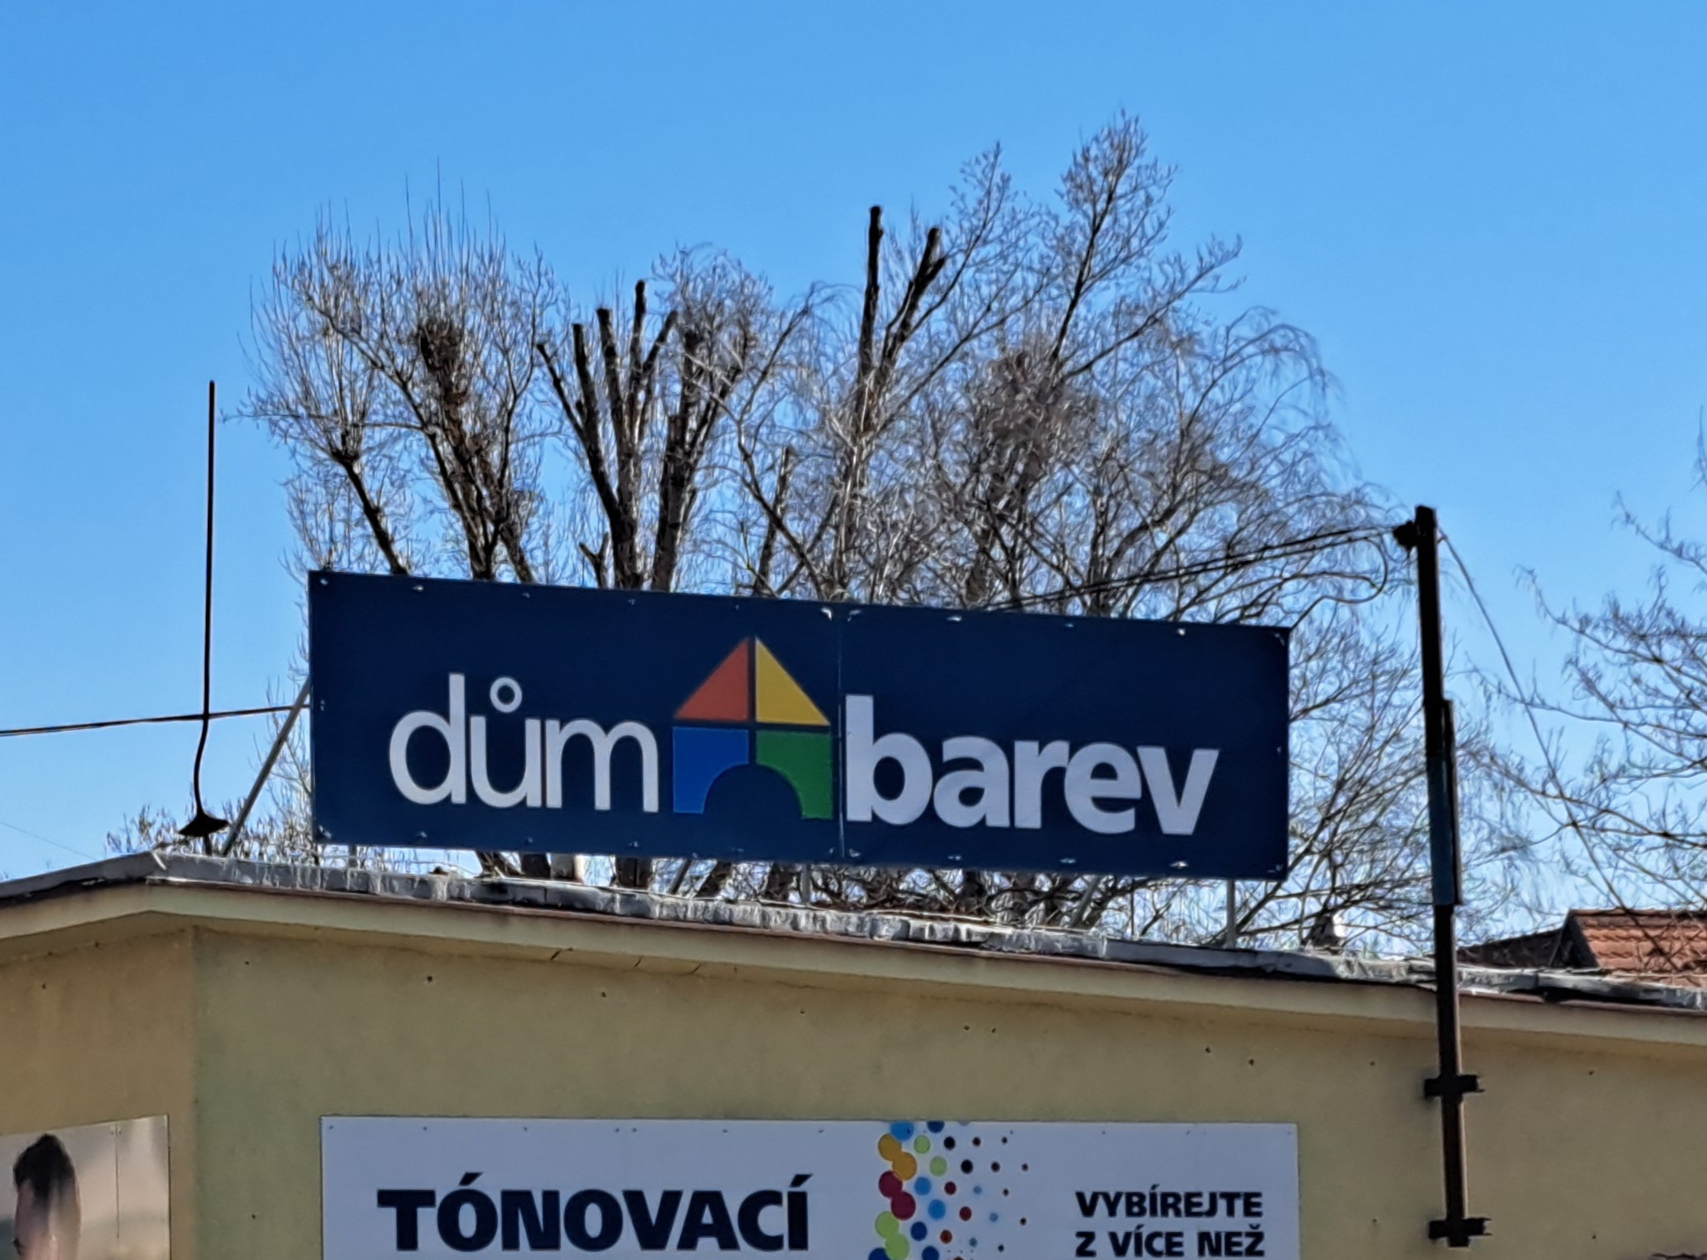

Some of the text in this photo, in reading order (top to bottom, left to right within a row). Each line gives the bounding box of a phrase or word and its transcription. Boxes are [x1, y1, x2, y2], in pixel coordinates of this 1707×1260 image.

[388, 672, 1220, 836] dům barev
[377, 1172, 813, 1252] TÓNOVACÍ
[1075, 1183, 1263, 1218] VYBÍREJTE
[1075, 1223, 1265, 1258] Z VÍCE NEŽ
